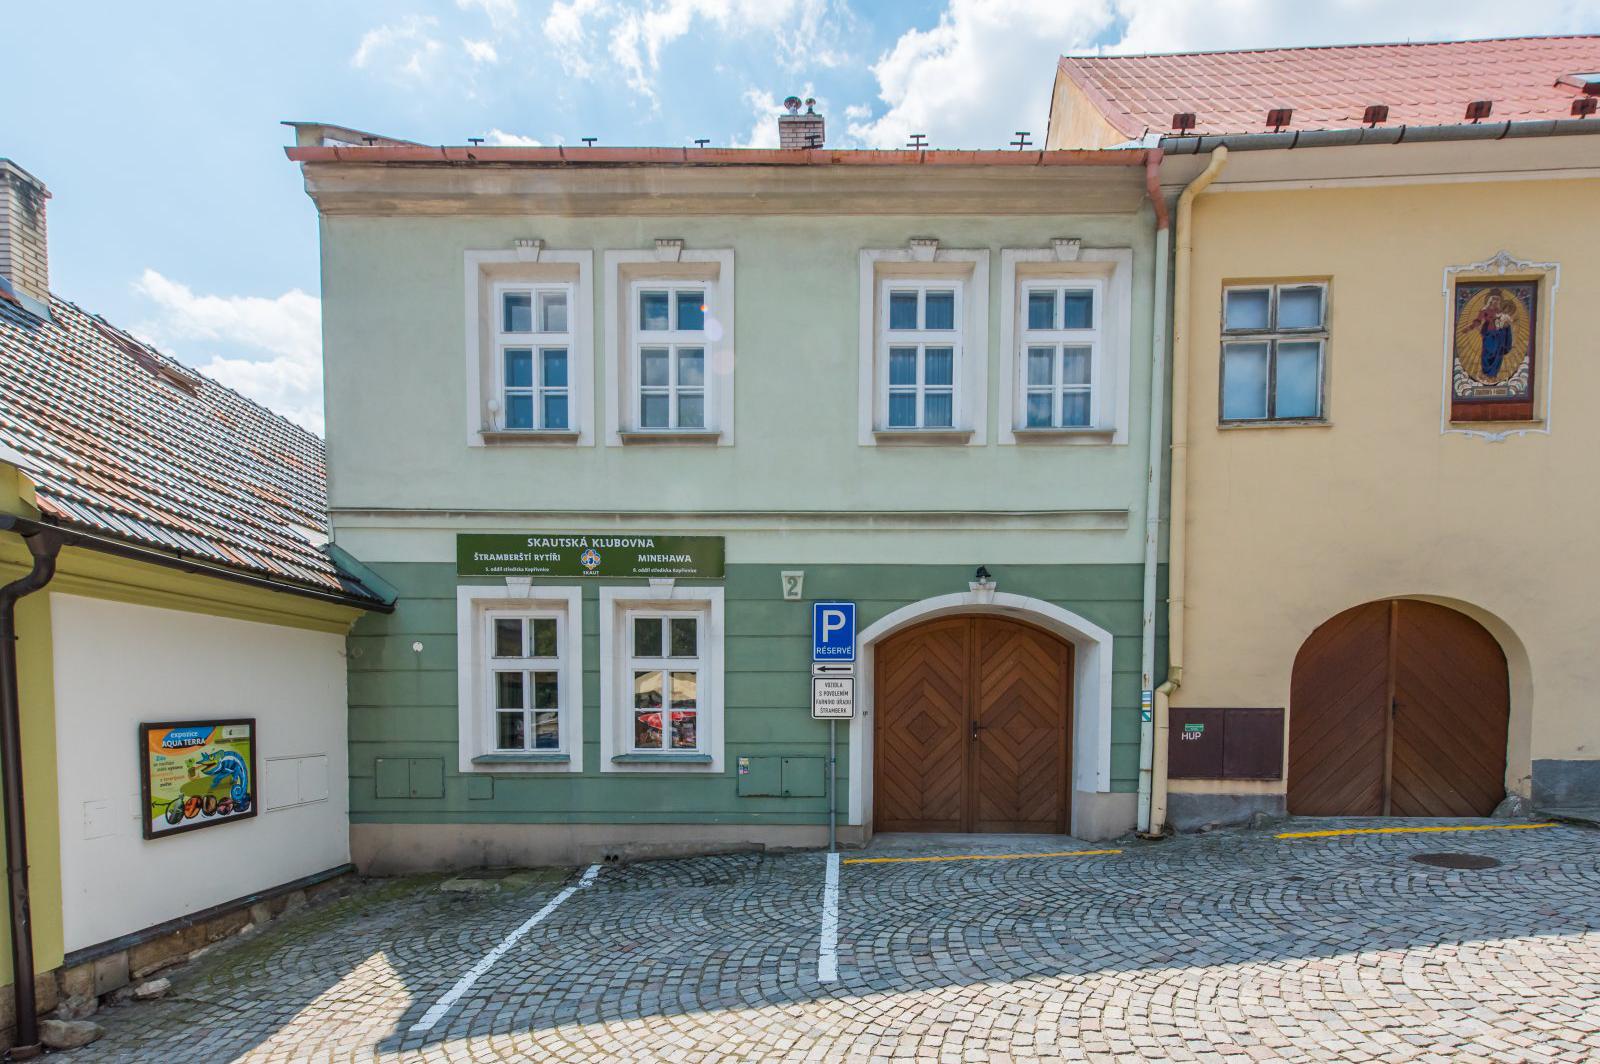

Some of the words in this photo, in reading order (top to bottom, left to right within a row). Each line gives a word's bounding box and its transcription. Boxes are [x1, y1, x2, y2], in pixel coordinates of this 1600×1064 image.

[527, 536, 588, 548] SKAUTSKÁ
[592, 538, 655, 548] KLUBOVNA
[474, 552, 532, 561] ŠTRAMBERŠTÍ
[535, 552, 561, 561] RYTÍŘI
[638, 554, 692, 563] MINEHAWA
[822, 610, 847, 643] P
[816, 646, 852, 655] RÉSERVÉ
[170, 731, 199, 739] expozice
[1181, 732, 1202, 740] HUP
[162, 740, 183, 749] AQUA
[184, 738, 206, 747] TERRA
